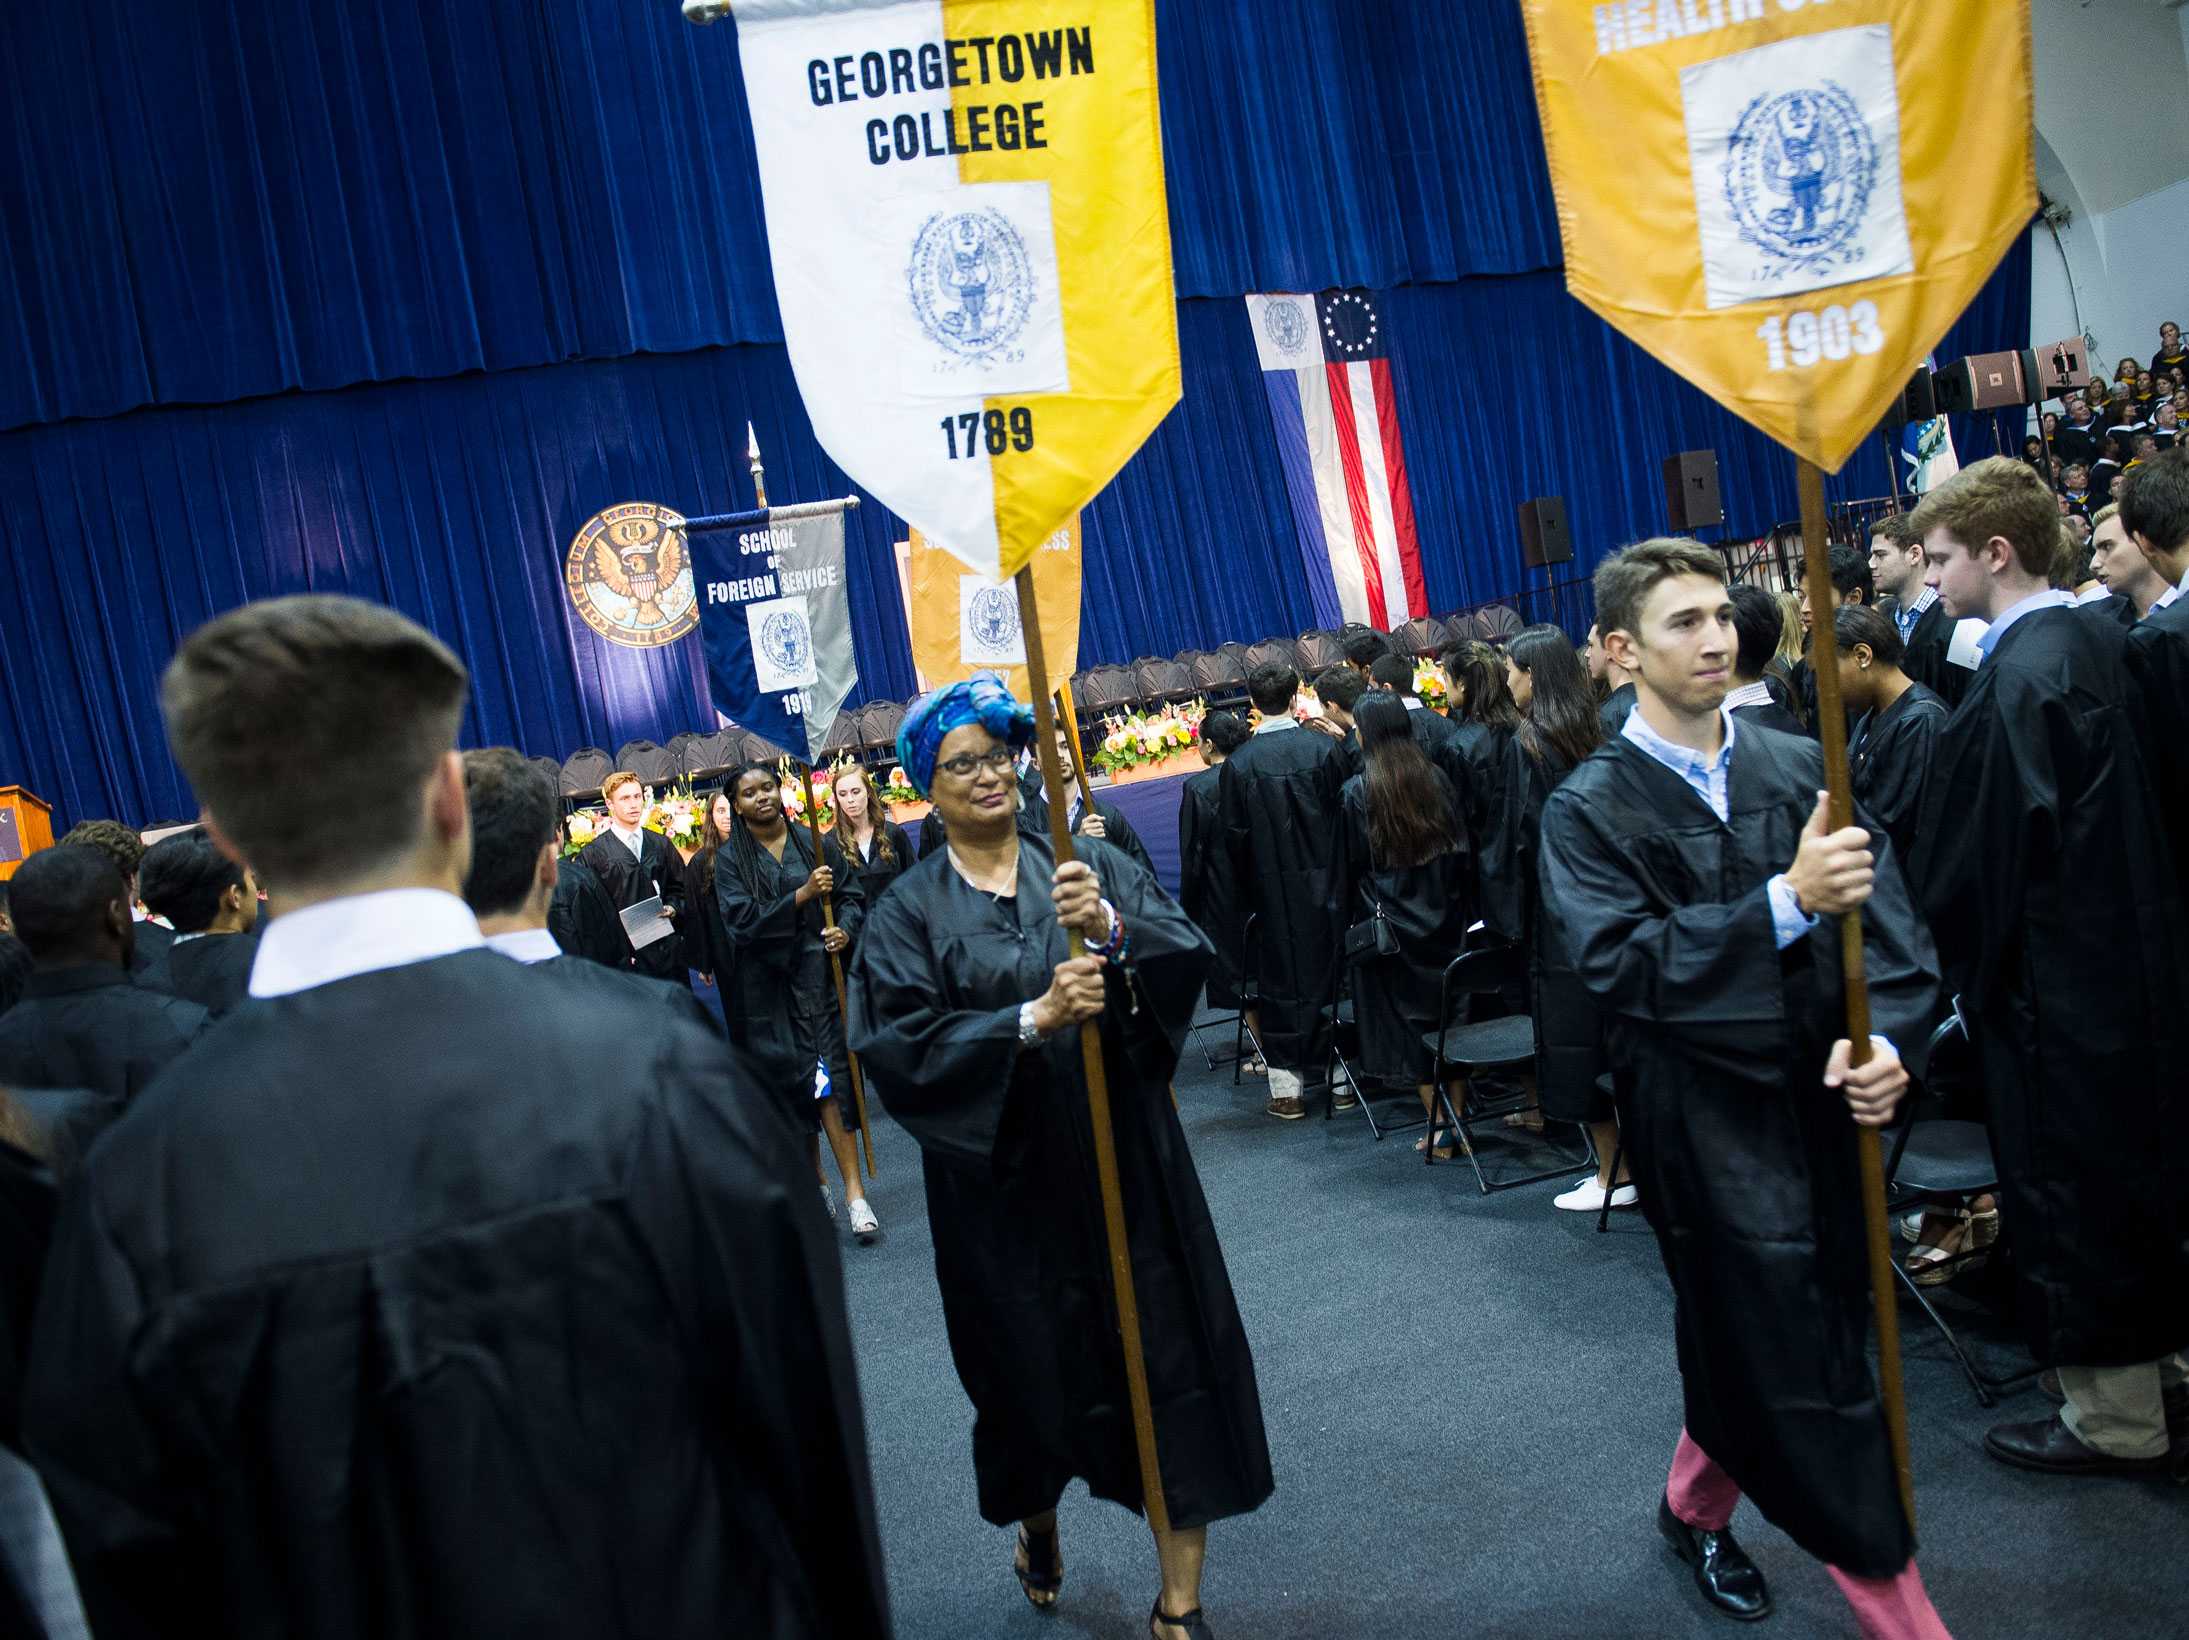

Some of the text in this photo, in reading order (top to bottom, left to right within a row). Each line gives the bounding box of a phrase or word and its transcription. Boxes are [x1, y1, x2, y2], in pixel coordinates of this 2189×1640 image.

[807, 26, 1095, 107] GEORGETOWN
[865, 101, 1048, 165] COLLEGE
[1756, 298, 1885, 372] 1903
[940, 406, 1034, 460] 1789
[738, 527, 798, 556] SCHOOL
[766, 555, 782, 570] OF
[707, 565, 838, 605] FOREIGN SERVICE
[781, 690, 813, 717] 1919
